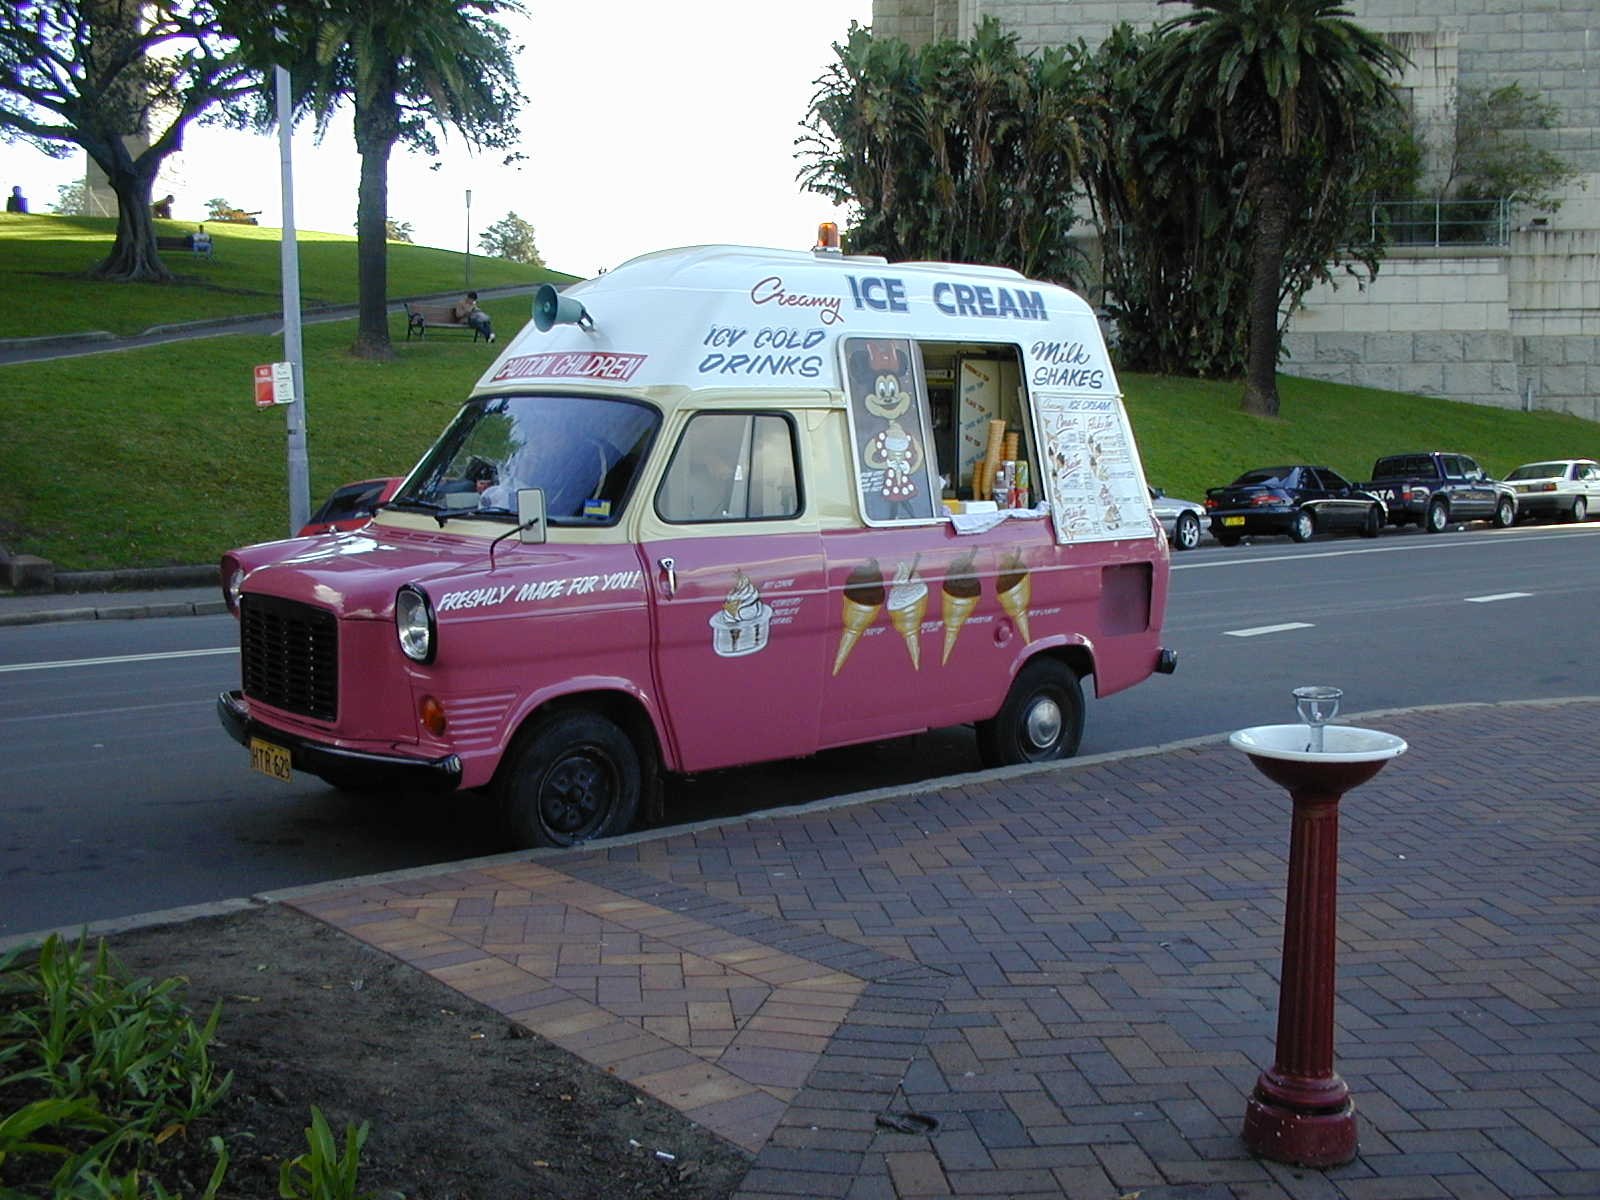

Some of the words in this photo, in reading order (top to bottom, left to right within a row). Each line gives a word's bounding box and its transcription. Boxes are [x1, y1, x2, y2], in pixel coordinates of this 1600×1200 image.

[750, 276, 844, 325] Creamy
[845, 274, 910, 313] ICE
[933, 281, 1049, 321] CREAM
[703, 326, 748, 348] ICY
[753, 328, 826, 349] COLD
[1031, 340, 1091, 365] Milk
[494, 354, 557, 379] CAUTION
[552, 352, 645, 379] CHILDREN
[698, 353, 823, 378] DRINKS
[1032, 366, 1104, 389] SHAKES
[437, 584, 516, 612] FRESHLY
[514, 579, 568, 603] MADE
[566, 575, 600, 597] FOR
[599, 570, 641, 591] YOU!
